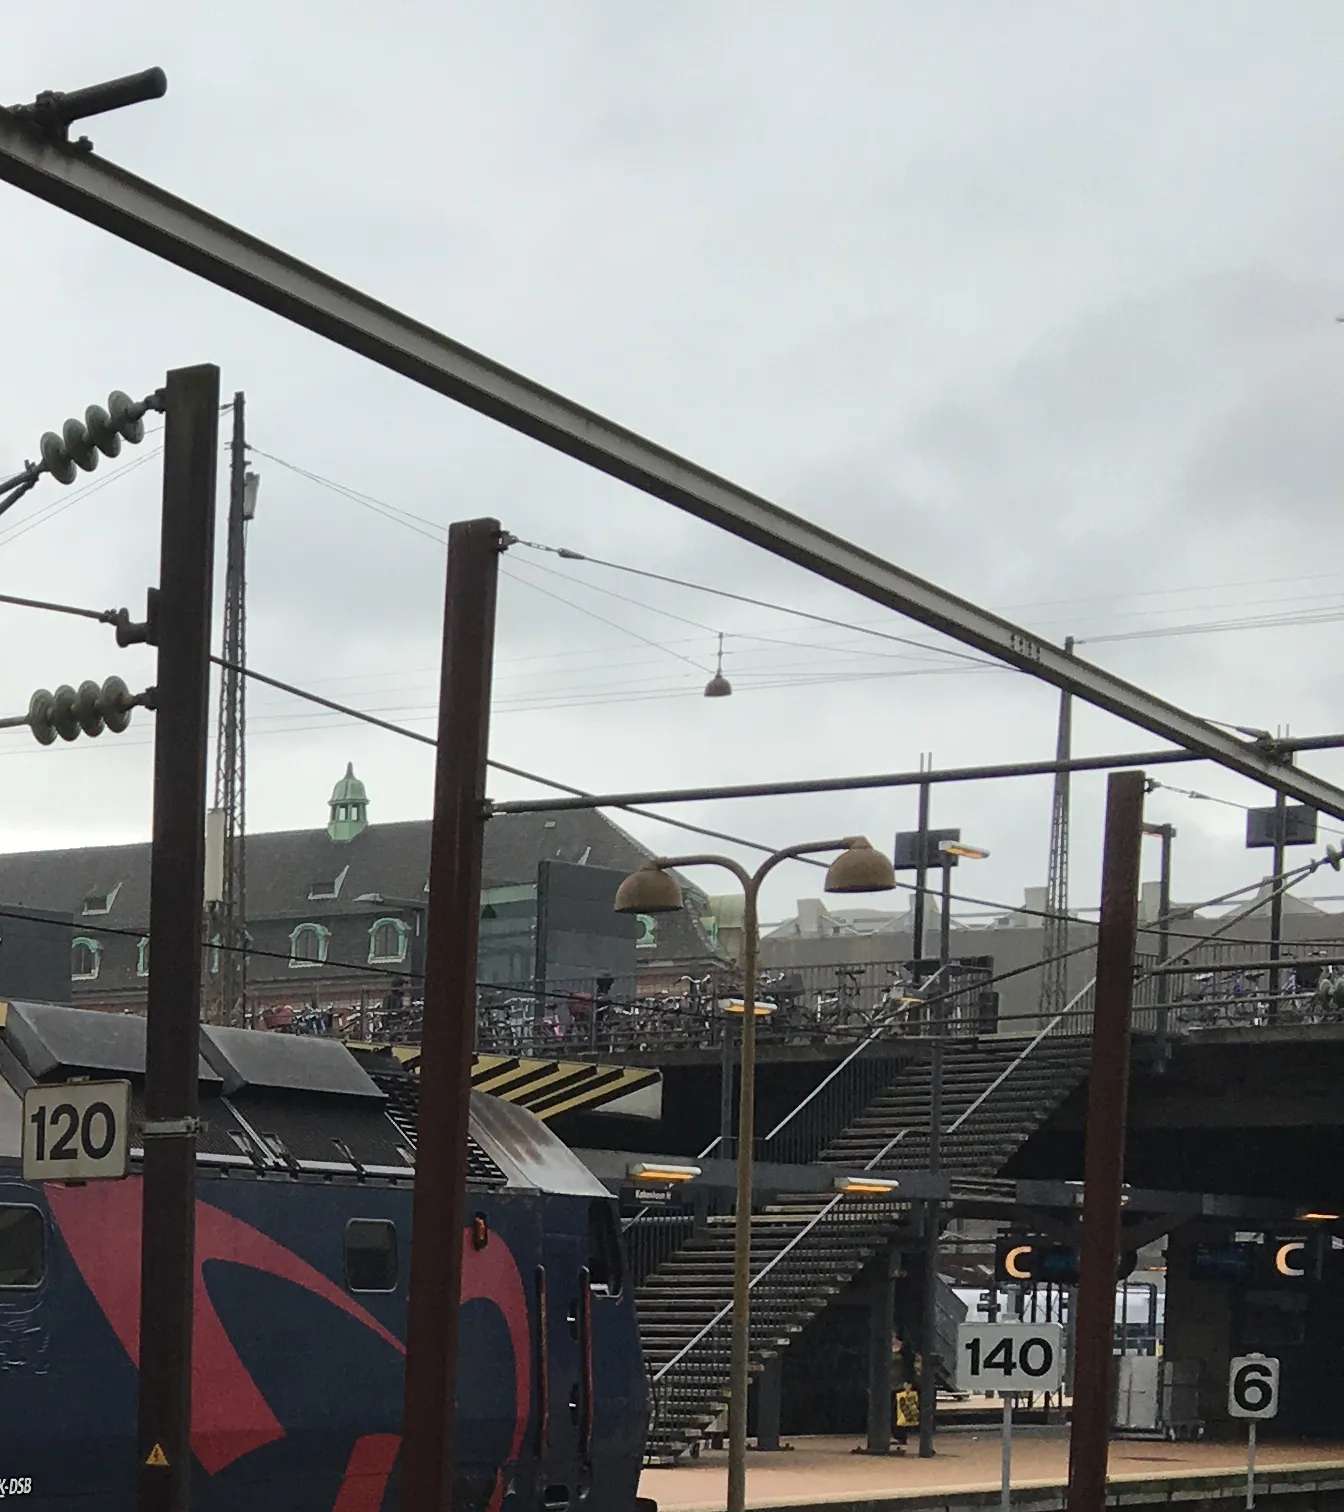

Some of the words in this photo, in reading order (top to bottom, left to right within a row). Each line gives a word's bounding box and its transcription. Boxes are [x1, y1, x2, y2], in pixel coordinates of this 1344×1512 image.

[30, 1101, 117, 1161] 120
[1004, 1245, 1033, 1280] C
[1275, 1242, 1305, 1276] C
[964, 1337, 1053, 1377] 140
[1234, 1363, 1273, 1412] 6
